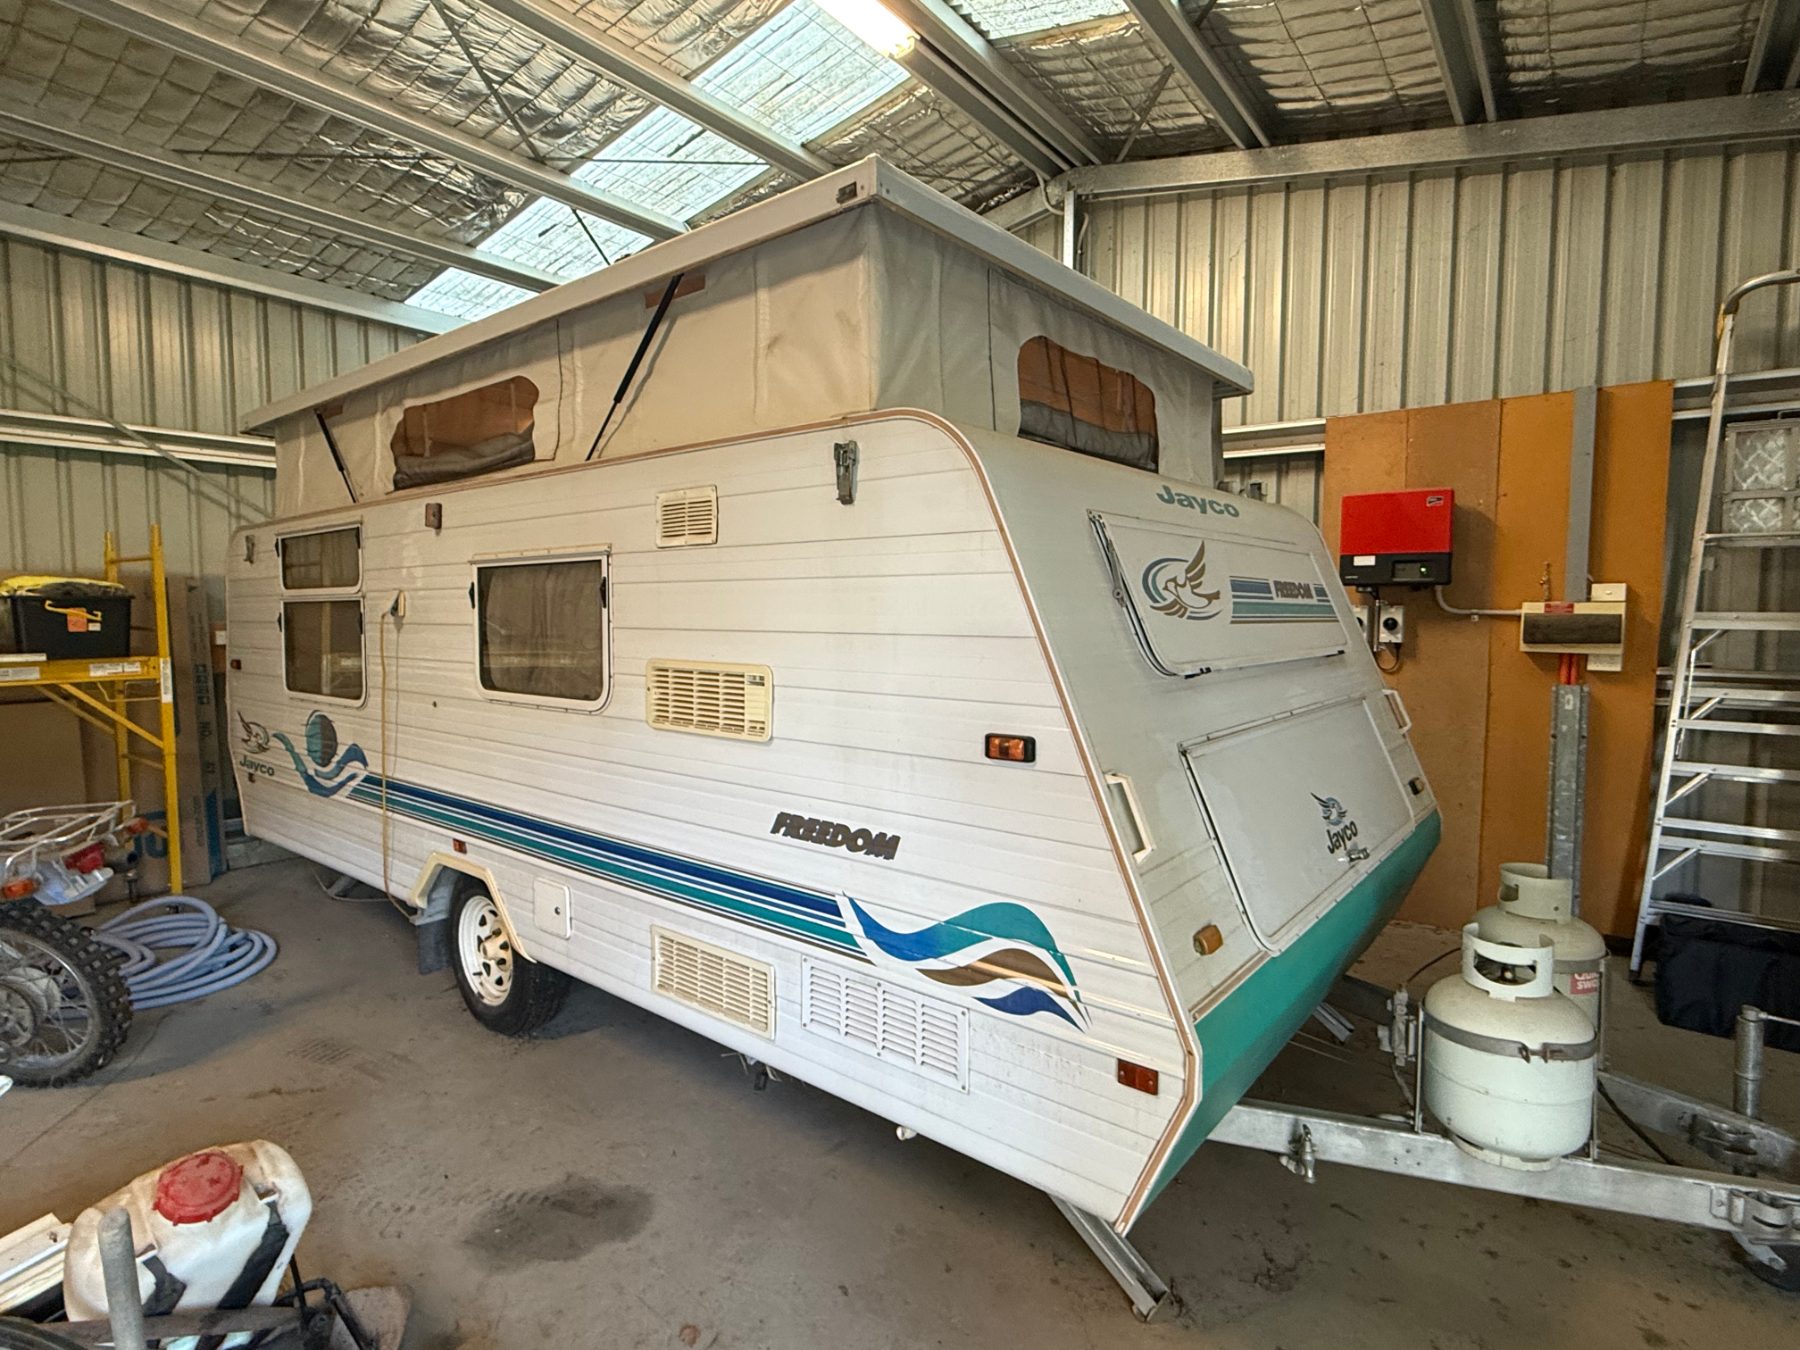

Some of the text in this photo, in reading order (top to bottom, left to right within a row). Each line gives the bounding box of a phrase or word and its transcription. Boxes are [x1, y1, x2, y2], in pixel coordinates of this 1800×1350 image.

[1156, 485, 1239, 517] Jayco
[1273, 580, 1314, 599] FREEDOM
[240, 755, 275, 776] Jayco
[770, 811, 901, 860] FREEDOM
[1326, 820, 1358, 854] Jayco
